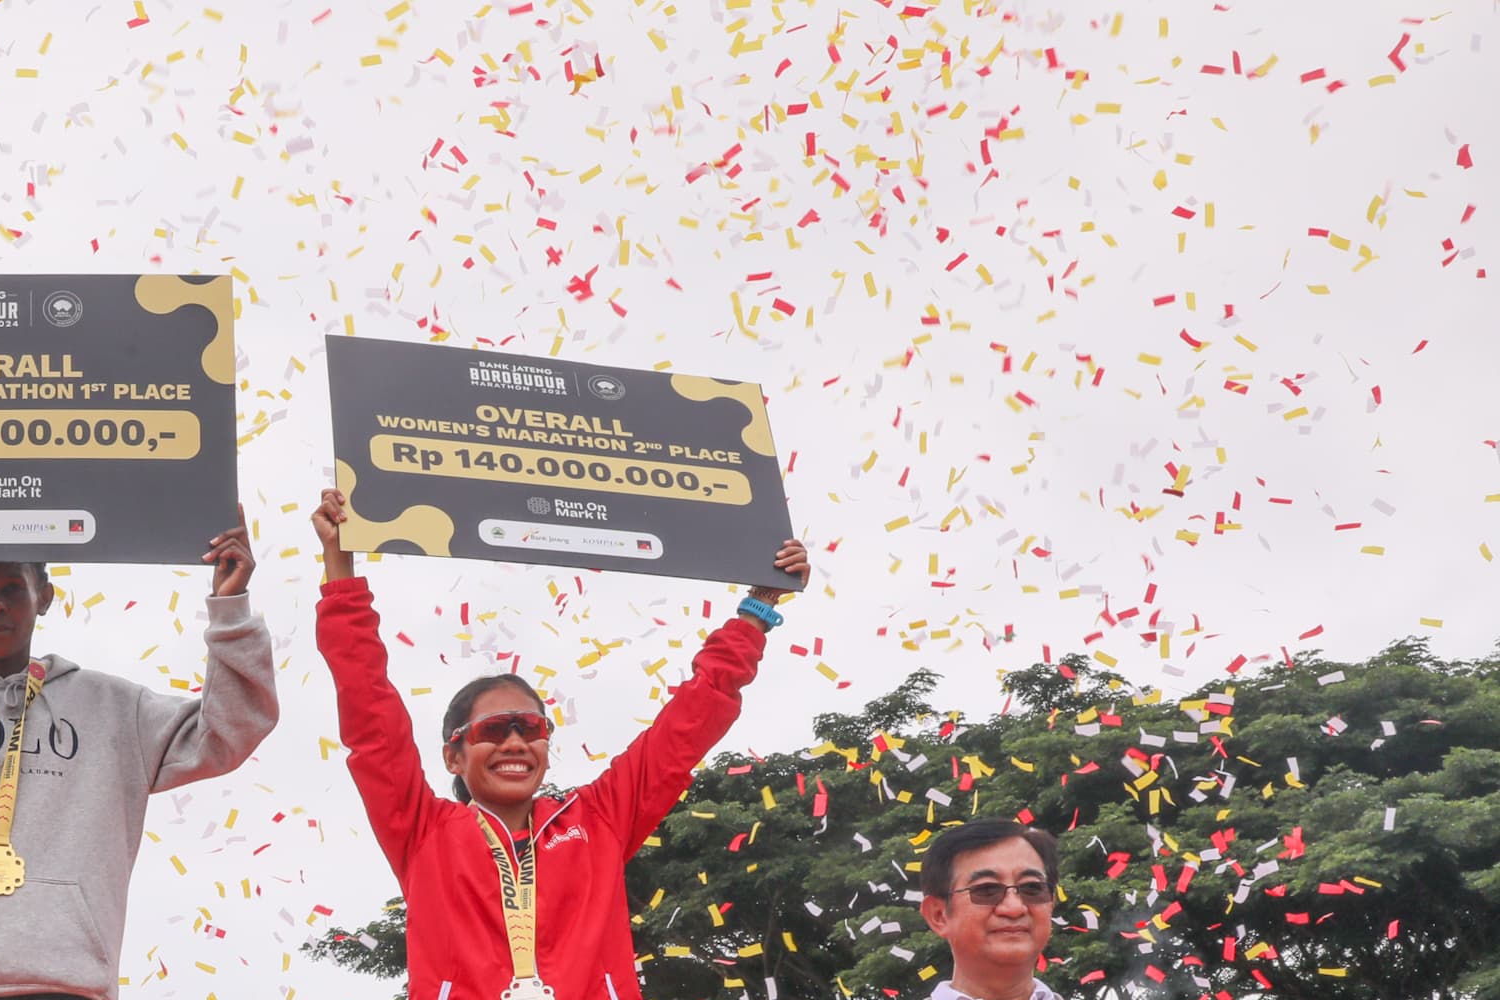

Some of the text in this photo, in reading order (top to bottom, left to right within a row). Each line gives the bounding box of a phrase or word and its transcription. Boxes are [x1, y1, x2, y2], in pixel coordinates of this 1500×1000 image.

[479, 361, 553, 375] BANK JATENG
[469, 368, 566, 390] BOROBUDUR
[81, 383, 106, 400] 1ST
[114, 383, 191, 400] PLACE
[471, 380, 567, 396] MARATHON 2024
[476, 404, 633, 437] OVERALL
[497, 427, 627, 452] MARATHON
[633, 441, 663, 454] 2ND
[669, 444, 743, 464] PLACE
[392, 443, 729, 497] Rp 140.000.000,-
[21, 476, 42, 487] On
[31, 486, 42, 498] It
[554, 499, 607, 512] Run On
[555, 508, 608, 521] Mark It
[492, 847, 520, 910] PODIUM
